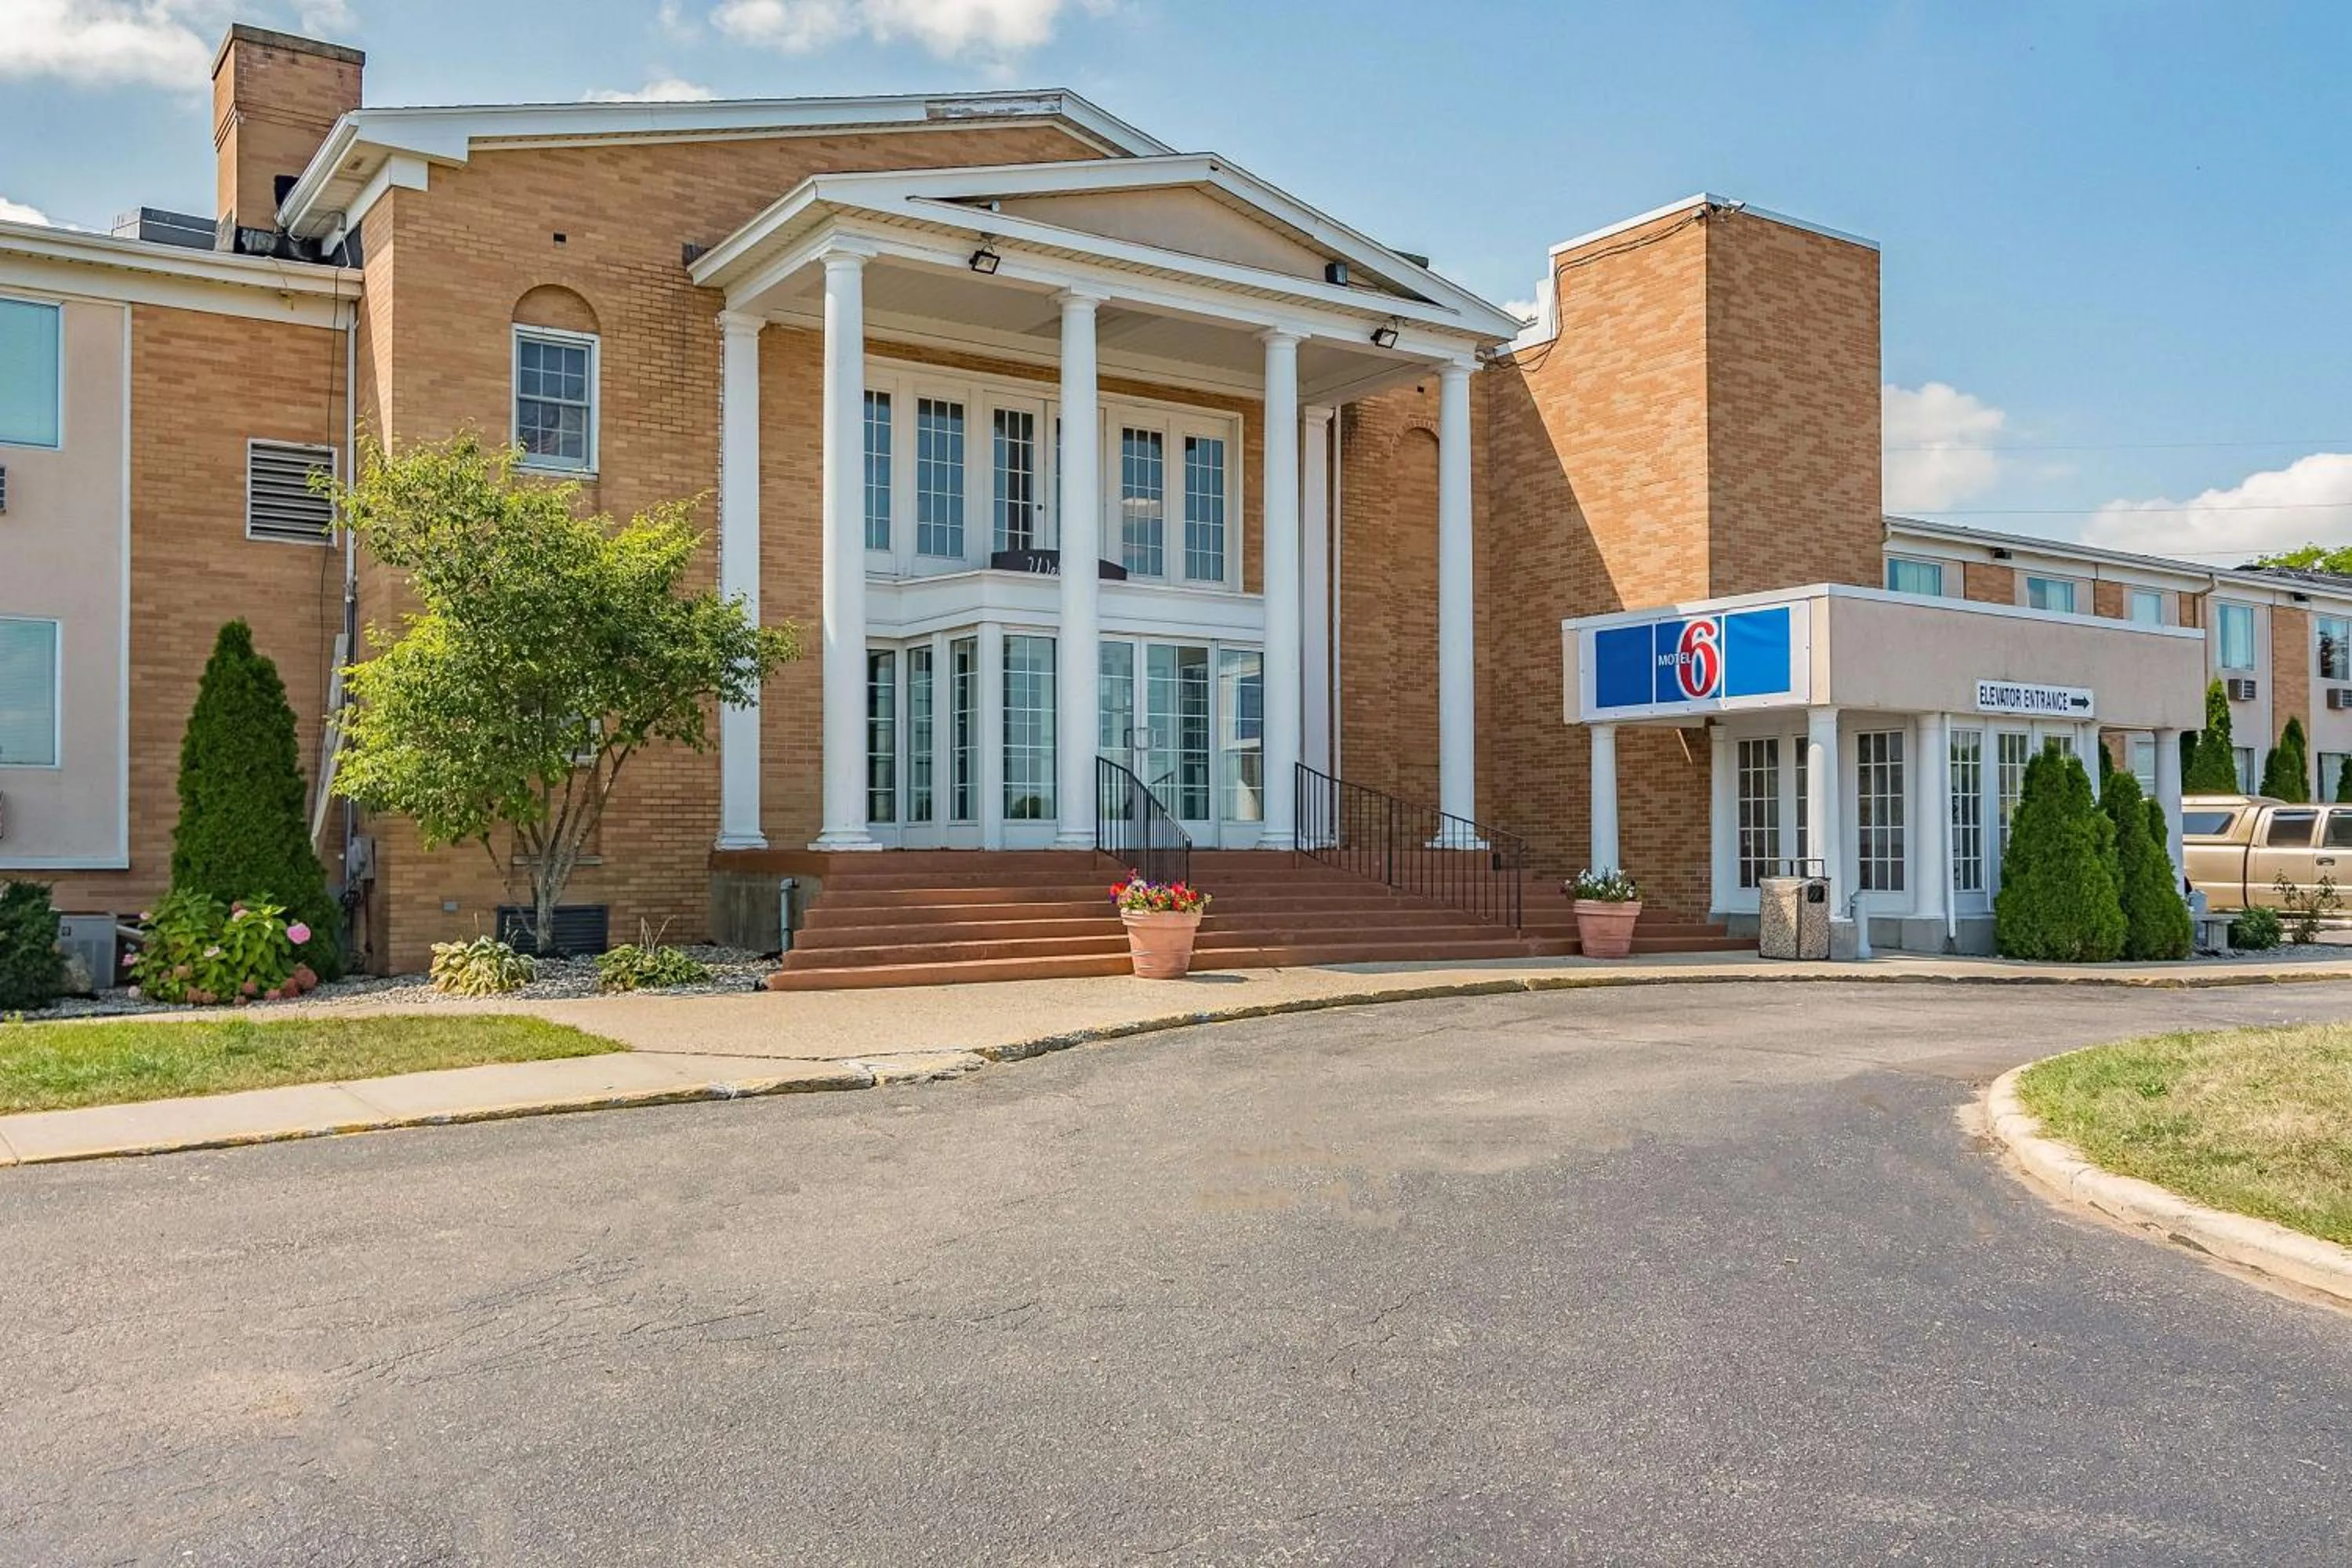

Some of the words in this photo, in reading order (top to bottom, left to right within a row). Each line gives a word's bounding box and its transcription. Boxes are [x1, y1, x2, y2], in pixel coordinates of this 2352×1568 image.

[1658, 652, 1692, 666] MOTEL
[1678, 619, 1719, 699] 6
[1980, 685, 2022, 708] ELEVATOR
[2024, 689, 2067, 711] ENTRANCE
